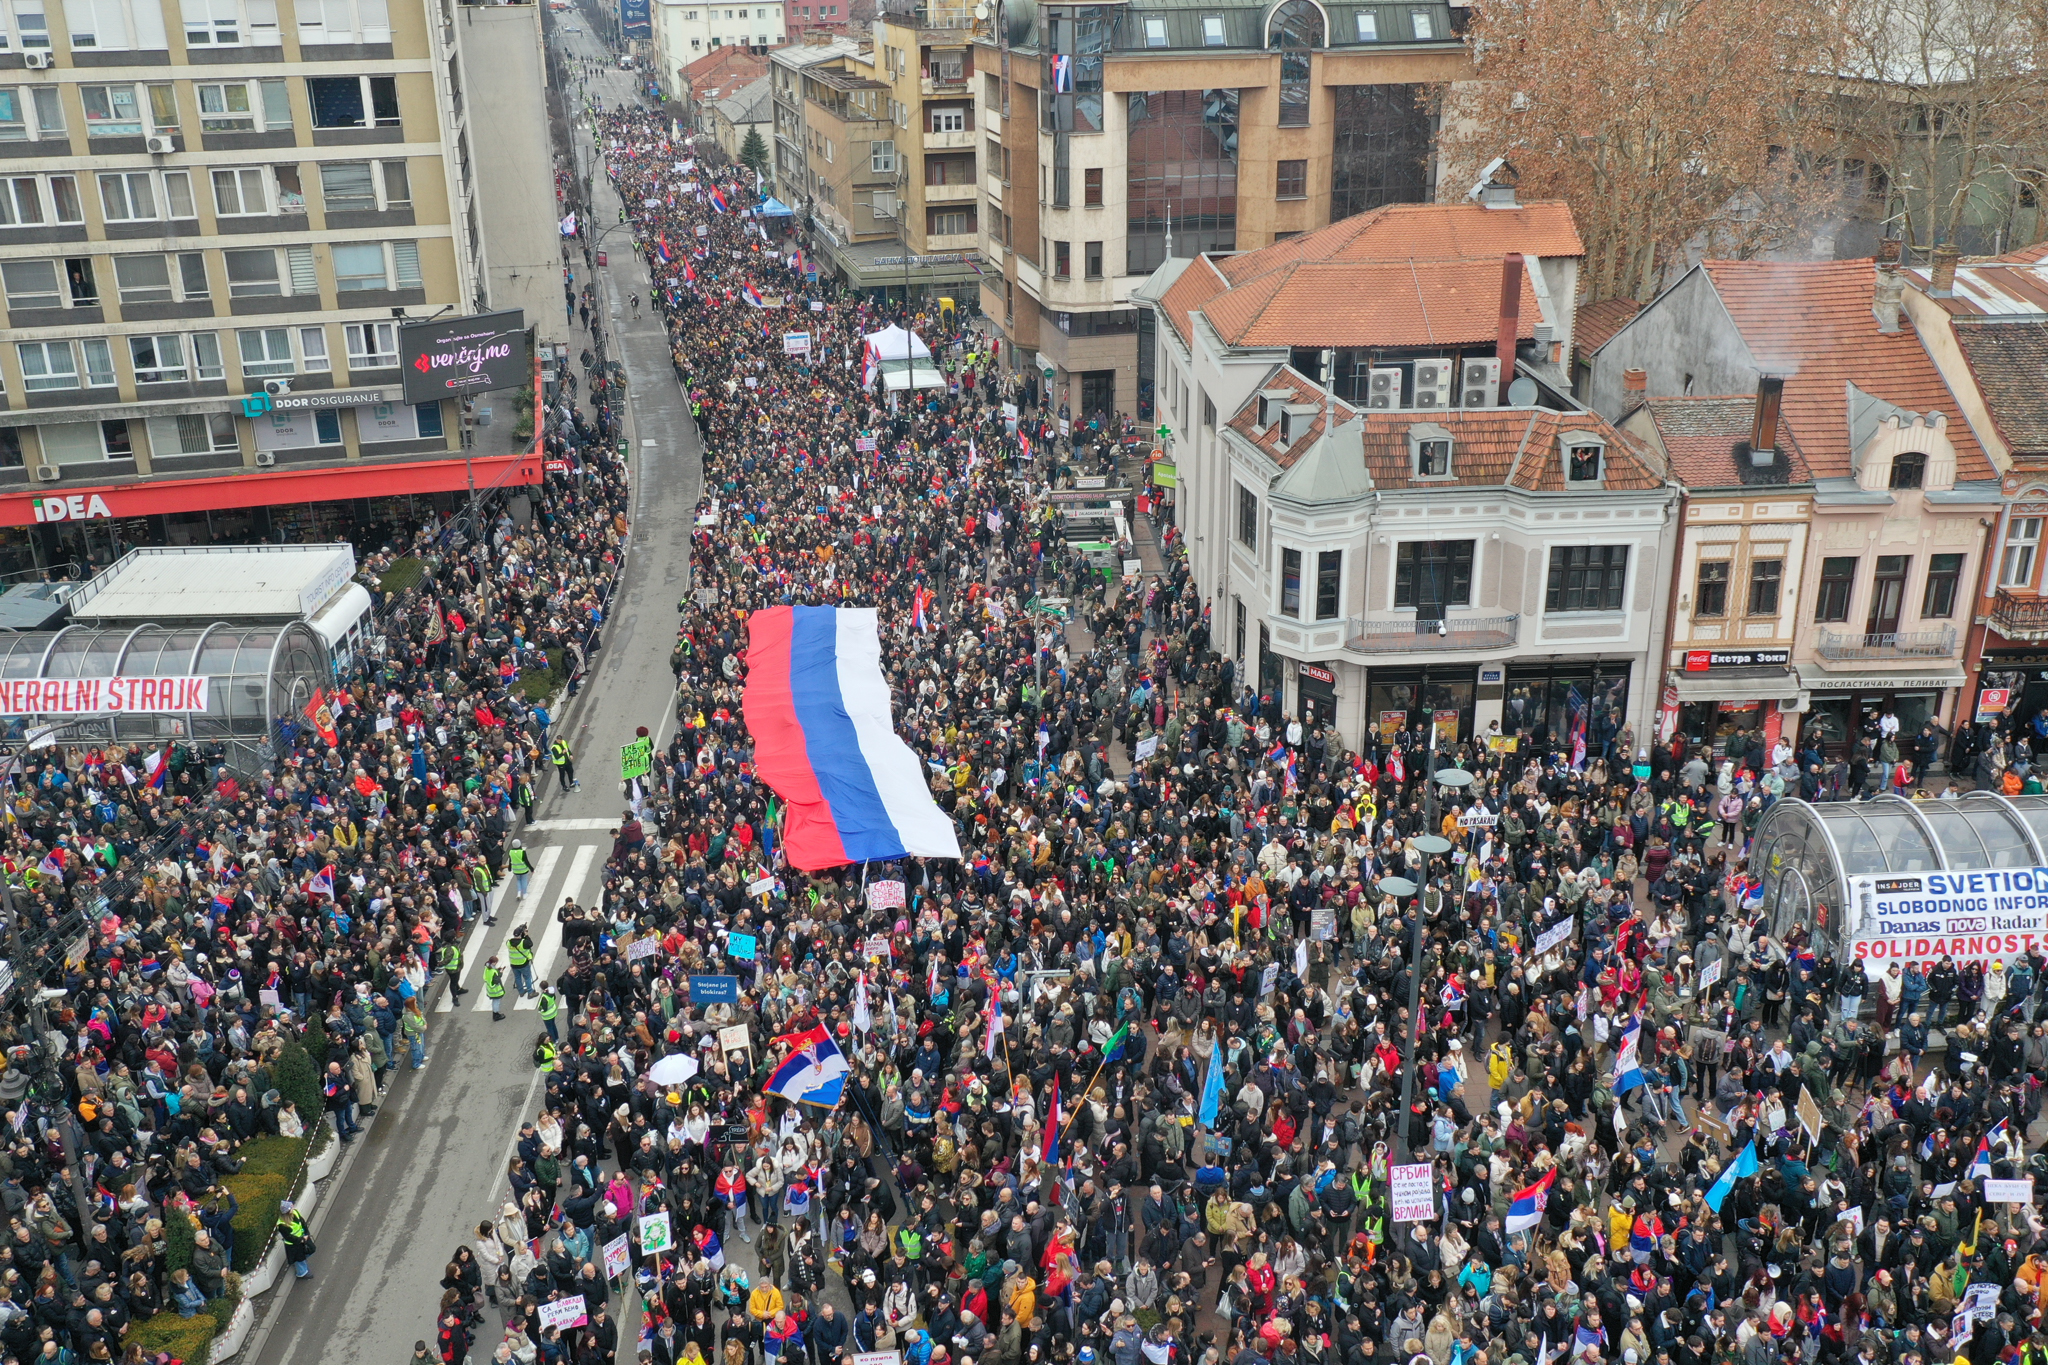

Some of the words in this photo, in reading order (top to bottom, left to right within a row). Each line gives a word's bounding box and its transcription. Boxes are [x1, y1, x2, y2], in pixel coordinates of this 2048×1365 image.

[874, 256, 904, 265] БАНКА
[276, 398, 308, 409] DDOR
[310, 393, 380, 406] OSIGURANJE
[306, 582, 324, 604] TOURIST
[335, 558, 350, 578] CENTER
[1710, 654, 1751, 664] Екстра
[1757, 653, 1786, 662] Зоки
[1310, 668, 1330, 681] MAXI
[1820, 680, 1894, 688] ПОСЛАСТИЧАРА
[108, 677, 204, 710] ŠTRAJK
[1470, 816, 1495, 824] PASARAN
[874, 882, 900, 890] САМО
[1877, 898, 1988, 916] SLOBODNOG
[1880, 920, 1940, 934] Danas
[1948, 918, 1986, 932] nova
[1991, 916, 2042, 930] Radar
[1854, 934, 2034, 959] SOLIDARNOST
[1392, 1165, 1430, 1180] СРБИН
[1394, 1204, 1432, 1220] ВРЛИНА
